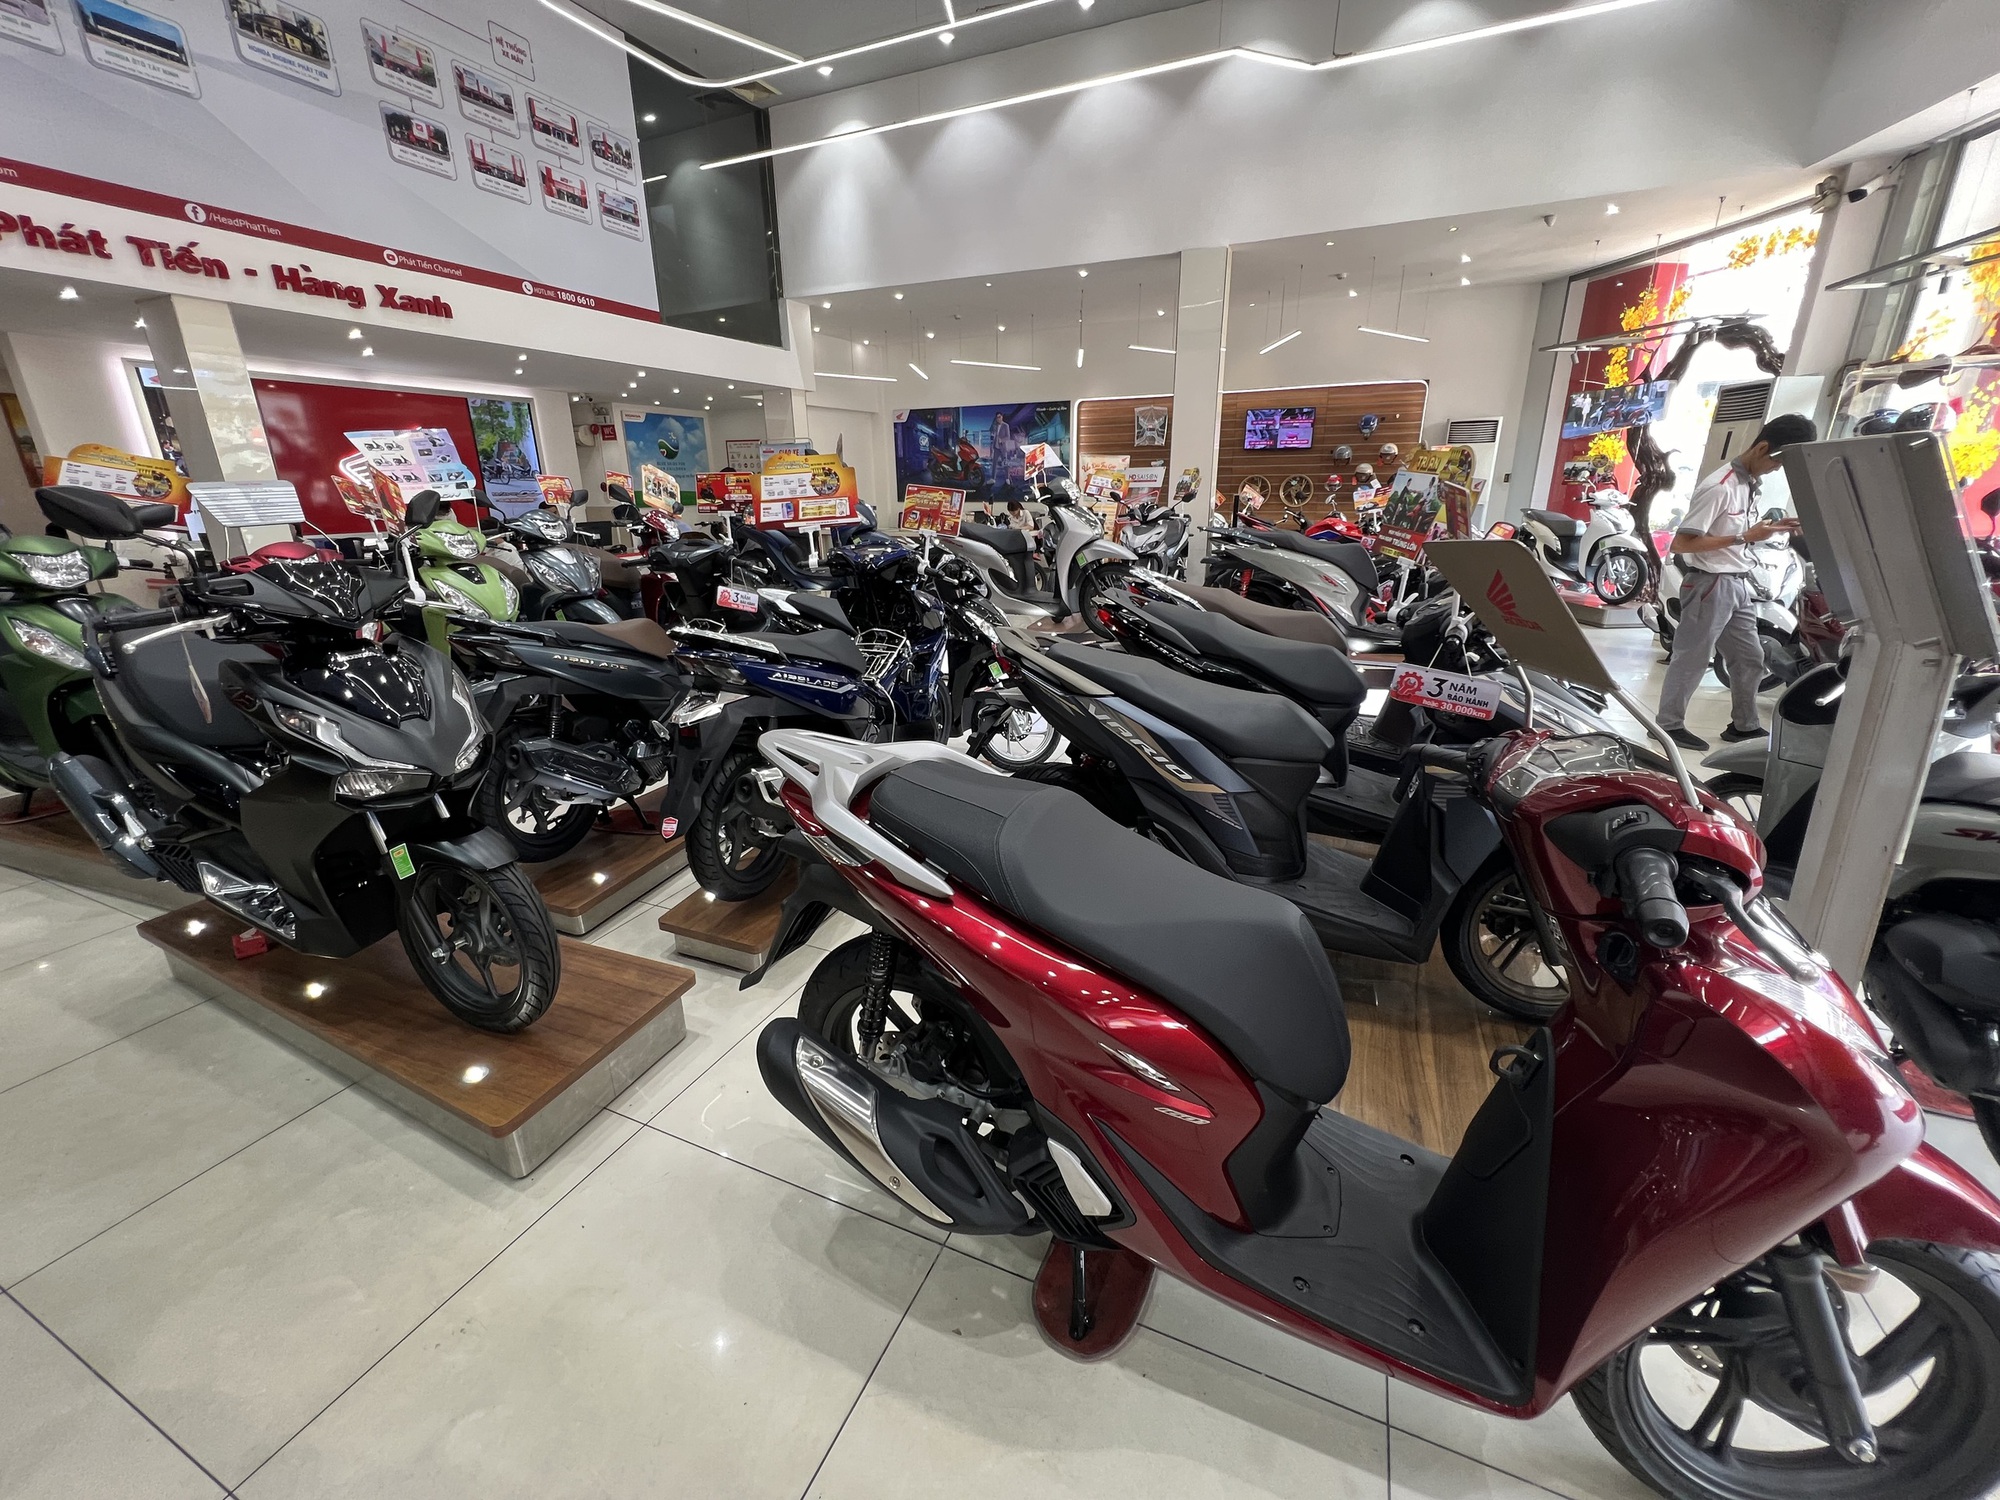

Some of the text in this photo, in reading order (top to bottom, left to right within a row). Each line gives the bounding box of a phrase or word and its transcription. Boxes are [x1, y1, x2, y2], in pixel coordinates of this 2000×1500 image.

[208, 211, 281, 236] /HeadPhatTien
[0, 210, 114, 260] Phát
[125, 241, 230, 280] Tiến
[271, 264, 367, 309] Hàng
[374, 284, 453, 319] Xanh
[398, 255, 417, 267] Phát
[433, 263, 463, 277] Channel
[557, 291, 576, 303] 1800
[577, 295, 595, 307] 6610
[603, 426, 614, 435] WC
[732, 592, 740, 603] 3
[772, 672, 839, 689] AIRBLADE
[1426, 677, 1478, 698] 3 NĂM
[1447, 693, 1489, 708] BẢO HÀNH
[1440, 701, 1487, 719] 30.000km
